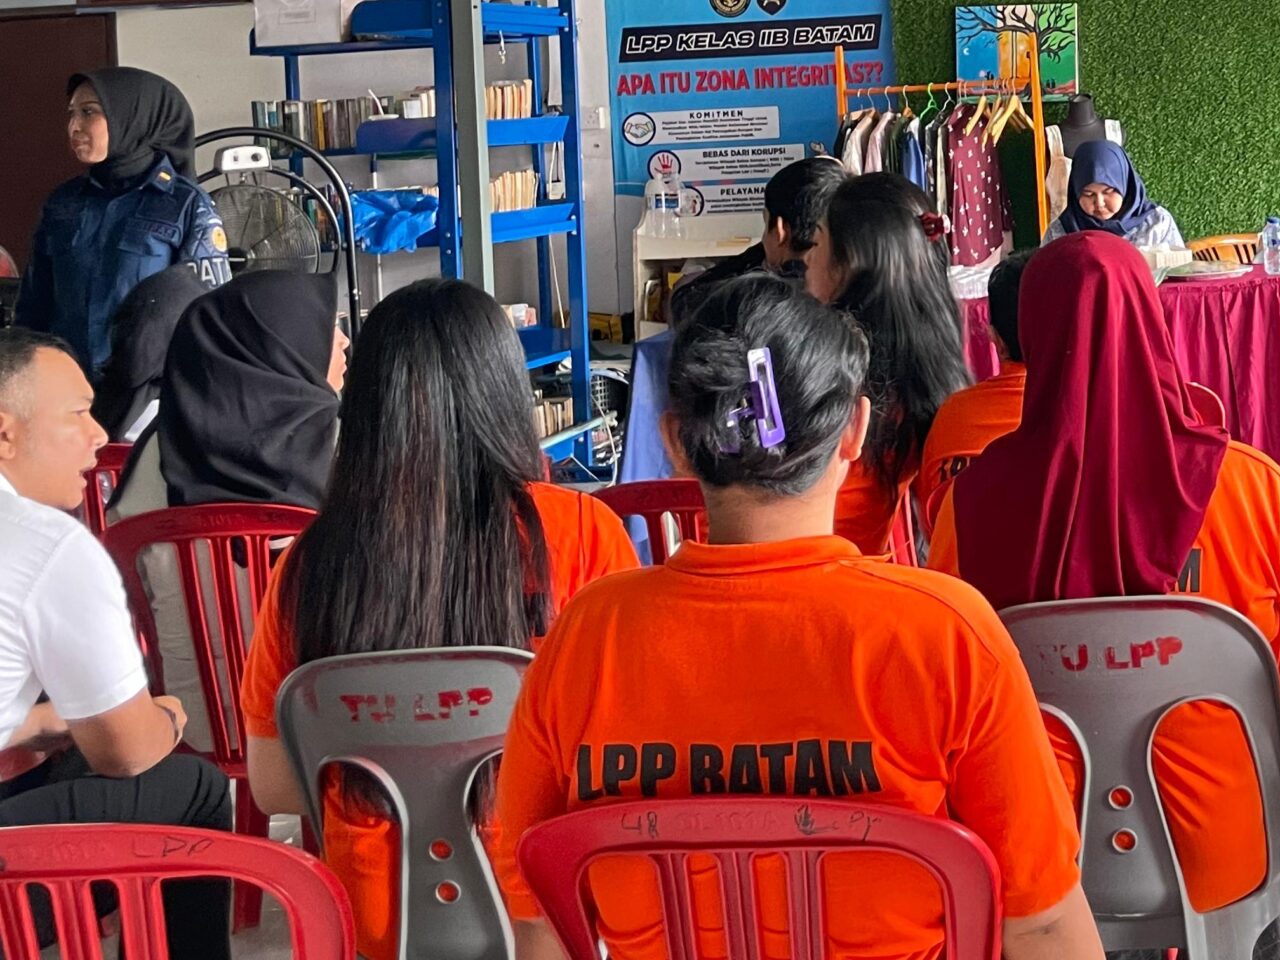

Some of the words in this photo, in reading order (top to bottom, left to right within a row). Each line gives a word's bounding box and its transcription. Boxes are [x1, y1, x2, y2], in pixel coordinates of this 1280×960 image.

[626, 33, 672, 54] LPP
[676, 30, 755, 51] KELAS
[759, 27, 788, 48] IIB
[793, 24, 876, 46] BATAM
[616, 74, 656, 96] APA
[659, 71, 691, 95] ITU
[695, 68, 750, 94] ZONA
[689, 110, 744, 120] KOMITMEN
[702, 150, 729, 159] BEBAS
[730, 149, 750, 158] DARI
[751, 147, 787, 156] KORUPSI
[1104, 636, 1183, 670] LPP
[577, 741, 677, 802] LPP
[689, 738, 884, 796] BATAM
